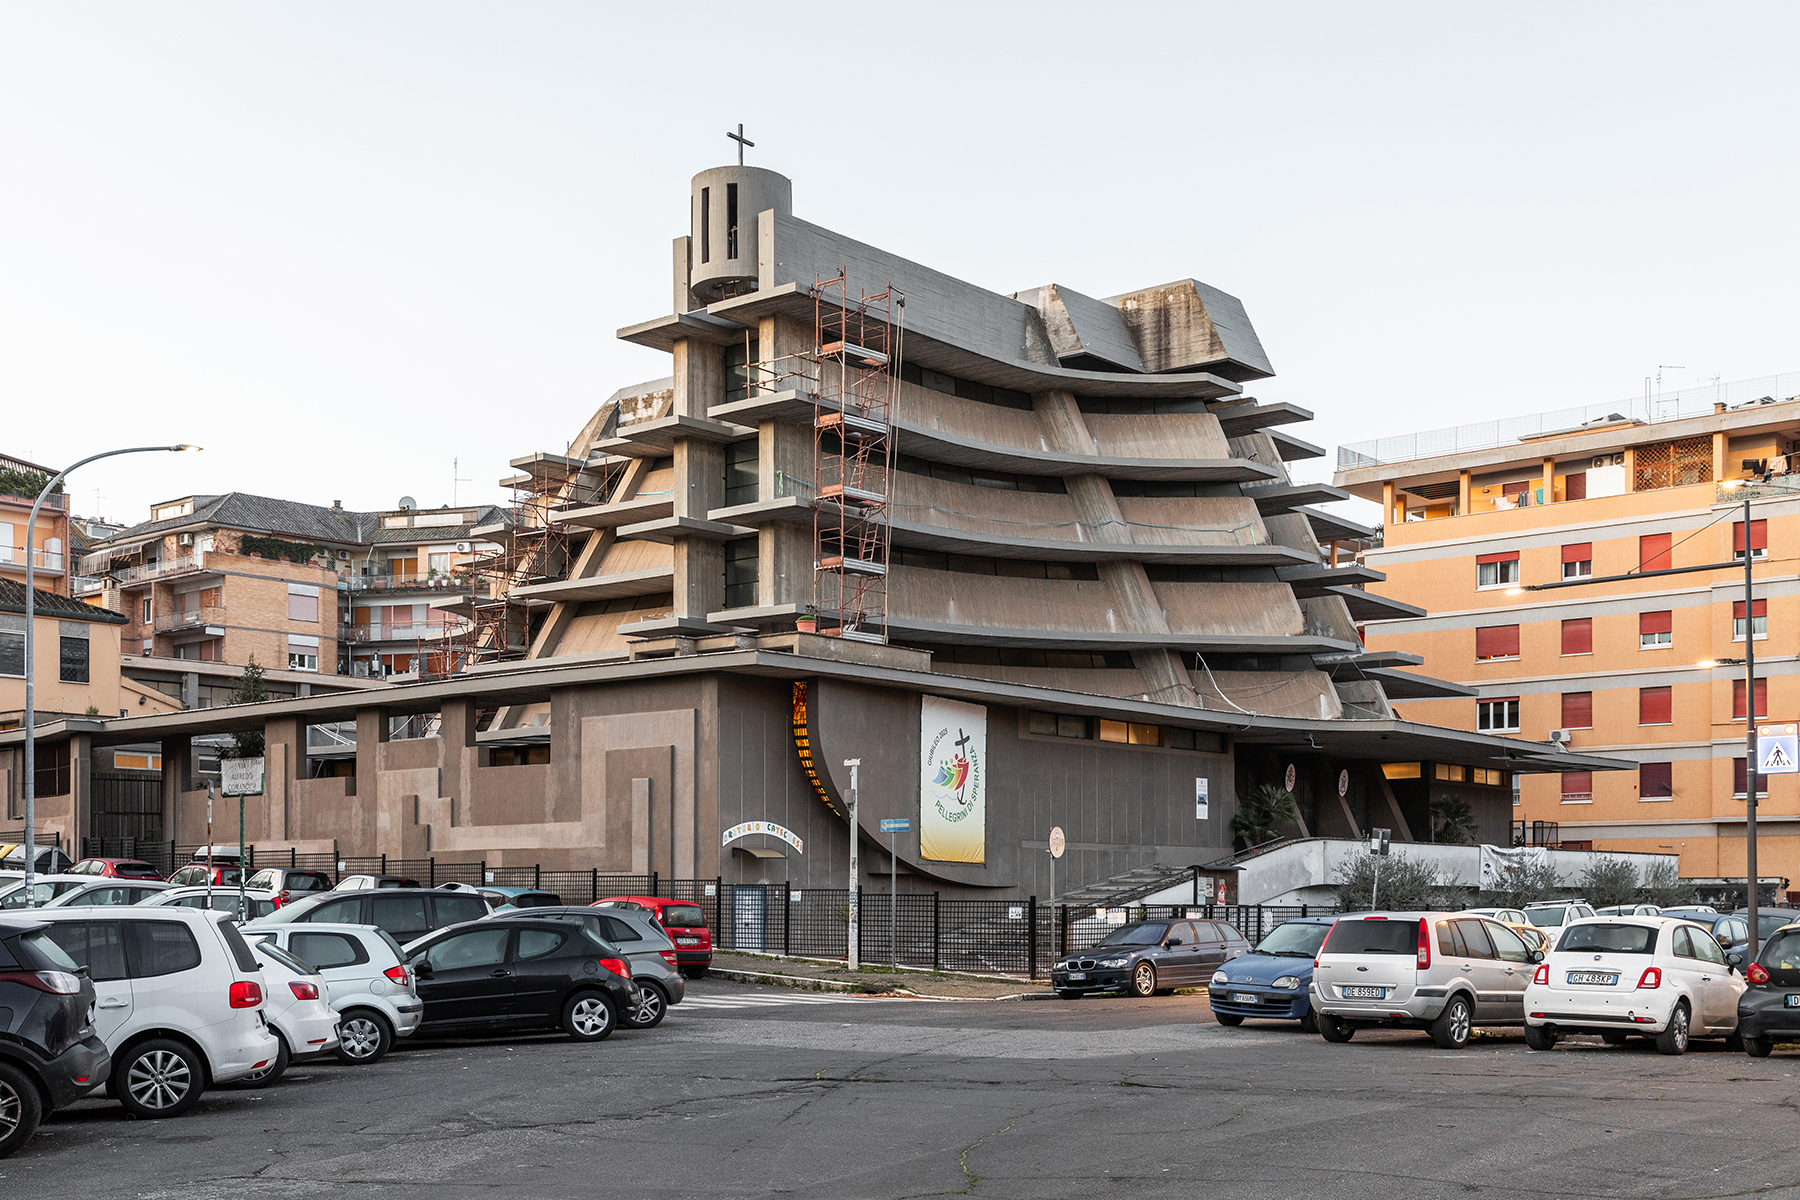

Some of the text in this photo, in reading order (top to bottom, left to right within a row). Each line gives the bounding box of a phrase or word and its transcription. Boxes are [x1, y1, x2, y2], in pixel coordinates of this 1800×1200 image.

[927, 727, 949, 767] GIUBILEO 2025
[237, 762, 246, 770] VIA
[231, 772, 253, 780] ALFREDO
[935, 745, 980, 823] PELLEGRINI DI SPERANZA
[1573, 973, 1584, 982] GH
[1346, 987, 1356, 996] DE
